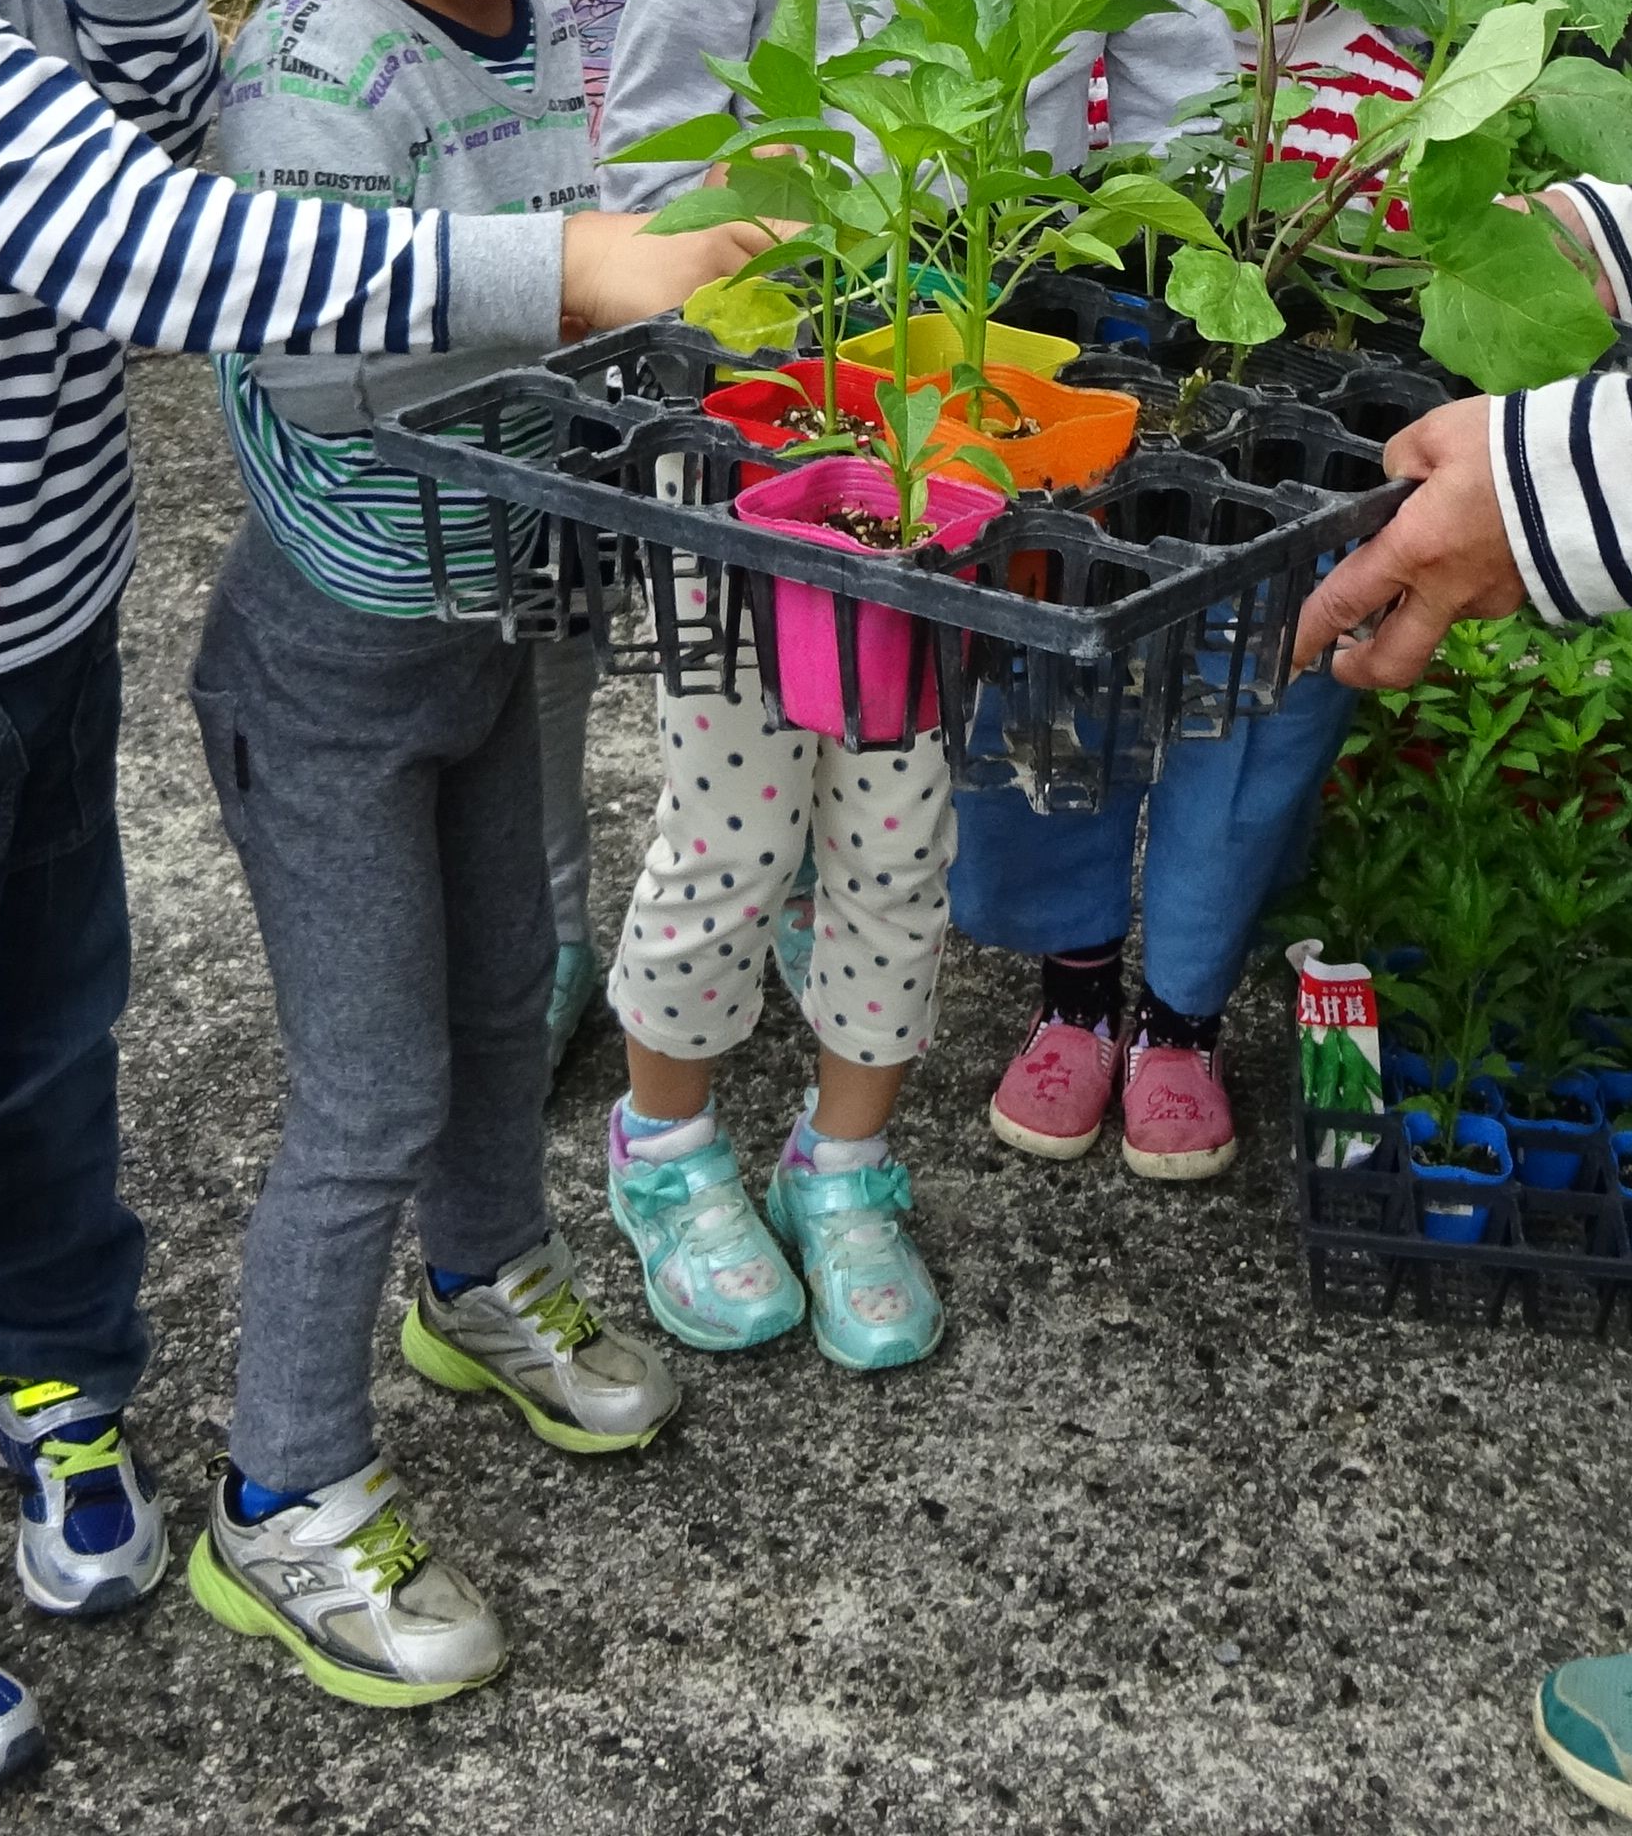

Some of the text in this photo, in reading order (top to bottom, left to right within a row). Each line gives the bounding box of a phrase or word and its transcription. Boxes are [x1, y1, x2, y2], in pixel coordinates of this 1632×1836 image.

[272, 168, 393, 193] RAD CUSTOM
[549, 187, 577, 207] RAD
